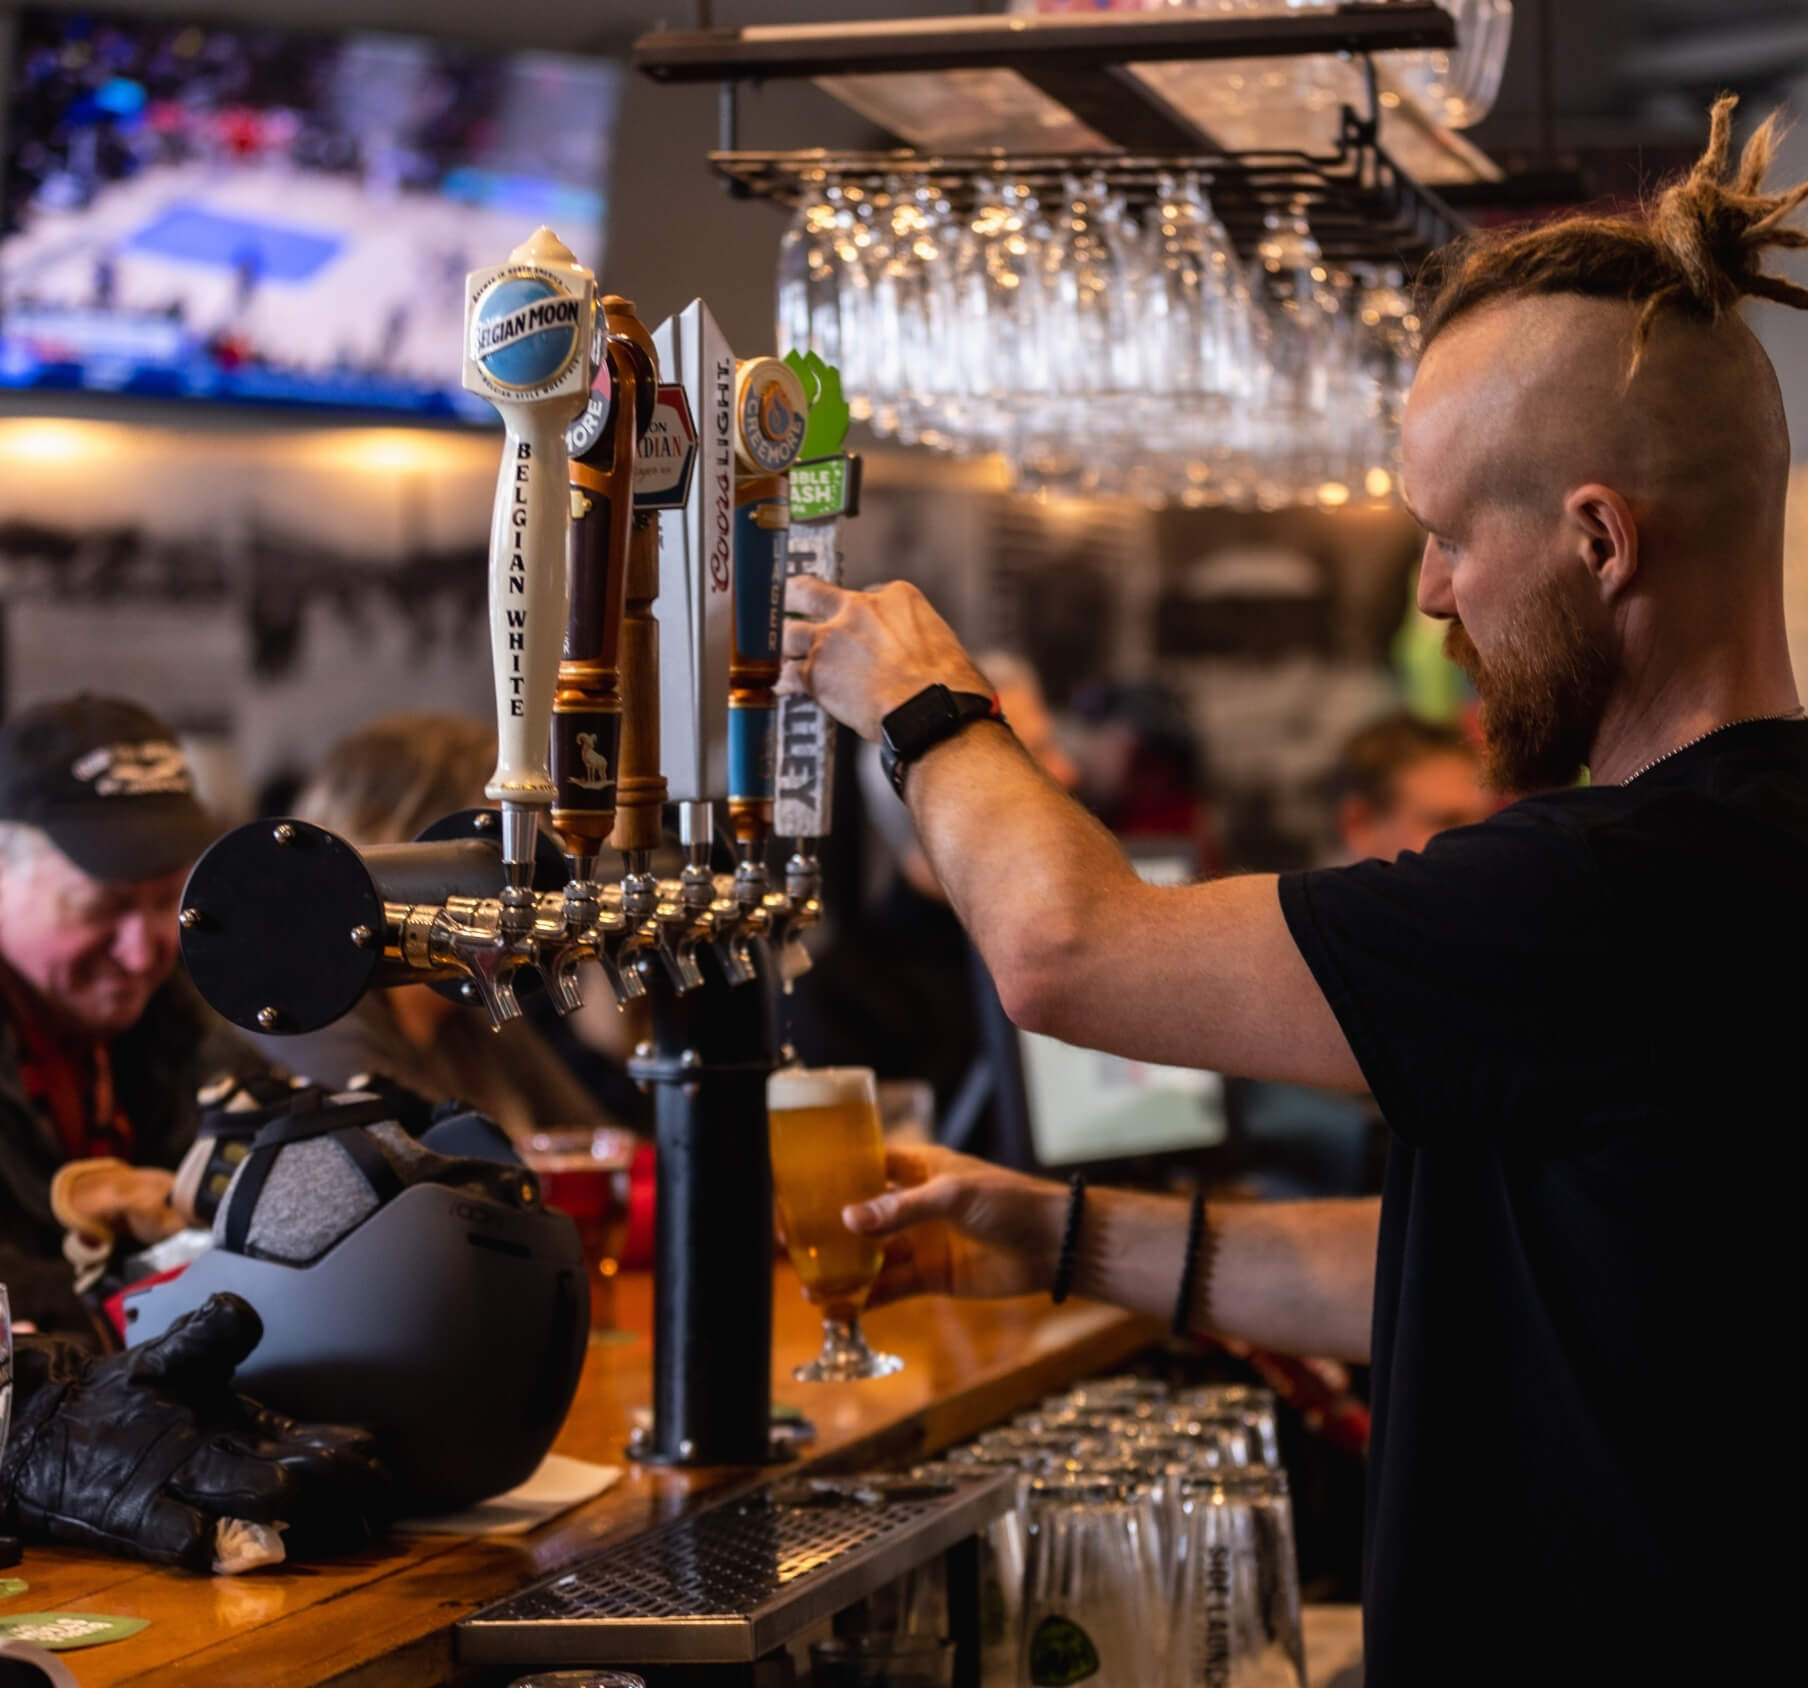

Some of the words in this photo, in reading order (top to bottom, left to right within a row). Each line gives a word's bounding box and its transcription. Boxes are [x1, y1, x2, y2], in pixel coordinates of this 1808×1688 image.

[528, 301, 579, 331] MOON
[747, 398, 803, 464] CREEMORE
[509, 442, 531, 594] BELGIAN
[711, 472, 731, 594] Coors
[506, 610, 527, 717] WHITE
